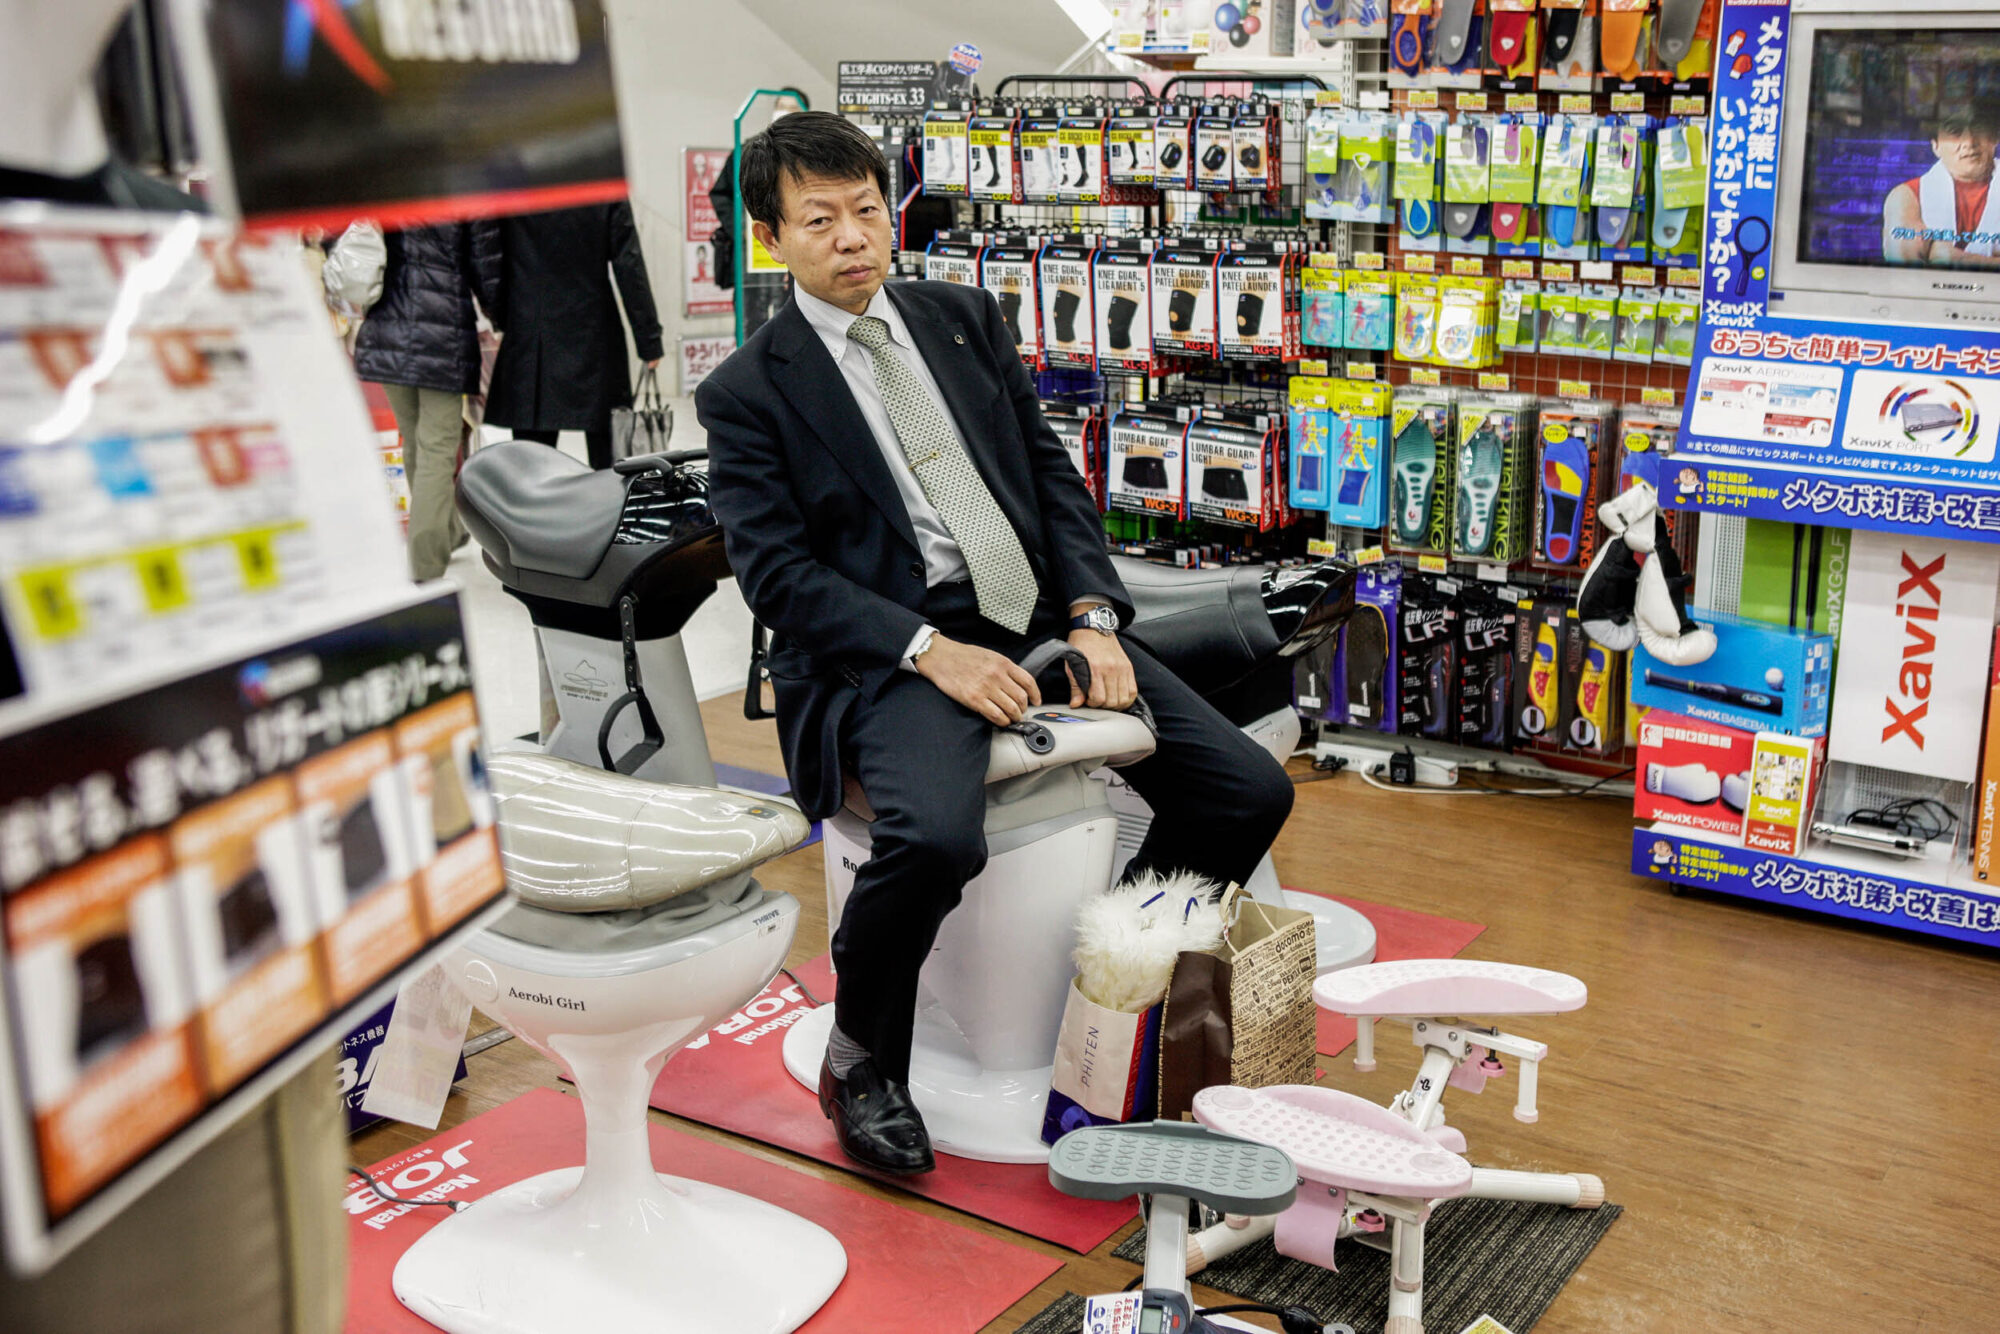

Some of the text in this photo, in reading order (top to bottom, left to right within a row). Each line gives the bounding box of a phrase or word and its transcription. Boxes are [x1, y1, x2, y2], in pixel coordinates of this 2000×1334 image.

[839, 92, 854, 105] CG
[909, 87, 925, 105] 33
[1745, 15, 1784, 190] メタボ対策に
[1708, 96, 1748, 292] いかがですか？
[929, 261, 969, 273] KNEE GUAR
[986, 266, 1003, 277] KNEE
[1043, 264, 1059, 275] KNEE
[1155, 267, 1175, 278] KNEE
[986, 276, 1024, 288] LIGAMENT
[1043, 273, 1087, 287] LIGAMENT 5
[1098, 269, 1140, 282] KNEE GUAR
[1222, 271, 1270, 282] KNEE GUAR
[1098, 280, 1146, 293] LIGAMENT 5
[1705, 298, 1765, 317] XaviX
[1705, 313, 1756, 328] XaviX
[1284, 315, 1292, 357] KG-5
[1184, 340, 1212, 352] KG-5
[1253, 344, 1280, 356] KG-5
[1020, 354, 1037, 365] L-3
[1068, 351, 1092, 363] KL-5
[1122, 358, 1148, 371] KL-5
[1712, 363, 1753, 374] XaviX
[1113, 431, 1147, 445] LUMBAR
[1849, 437, 1893, 449] XaviX
[1113, 444, 1134, 455] LIGHT
[1191, 441, 1225, 456] LUMBAR
[1191, 452, 1213, 465] LIGHT
[1144, 497, 1177, 513] WG-3
[1224, 507, 1258, 524] WG-3
[1824, 532, 1849, 648] aviX GOLF
[1404, 607, 1445, 626] 低反発インソー
[1465, 615, 1504, 634] 低反発インソー
[1404, 618, 1449, 643] LR
[1464, 626, 1510, 652] LR
[1882, 549, 1947, 752] XaviX
[1686, 704, 1722, 721] XaviX
[1799, 723, 1824, 737] XaviX
[1757, 803, 1793, 817] XaviX
[1652, 808, 1740, 833] XaviX POWER
[1978, 779, 1998, 869] XaviX TENNIS
[1748, 833, 1791, 851] XaviX
[1750, 858, 2000, 932] メタボ対策・改善は
[752, 909, 780, 926] THRIVE
[1275, 930, 1306, 953] docomo
[508, 985, 587, 1012] Aerobi Girl
[733, 1005, 812, 1046] National
[1081, 1025, 1100, 1088] PHITEN
[363, 1173, 481, 1231] National
